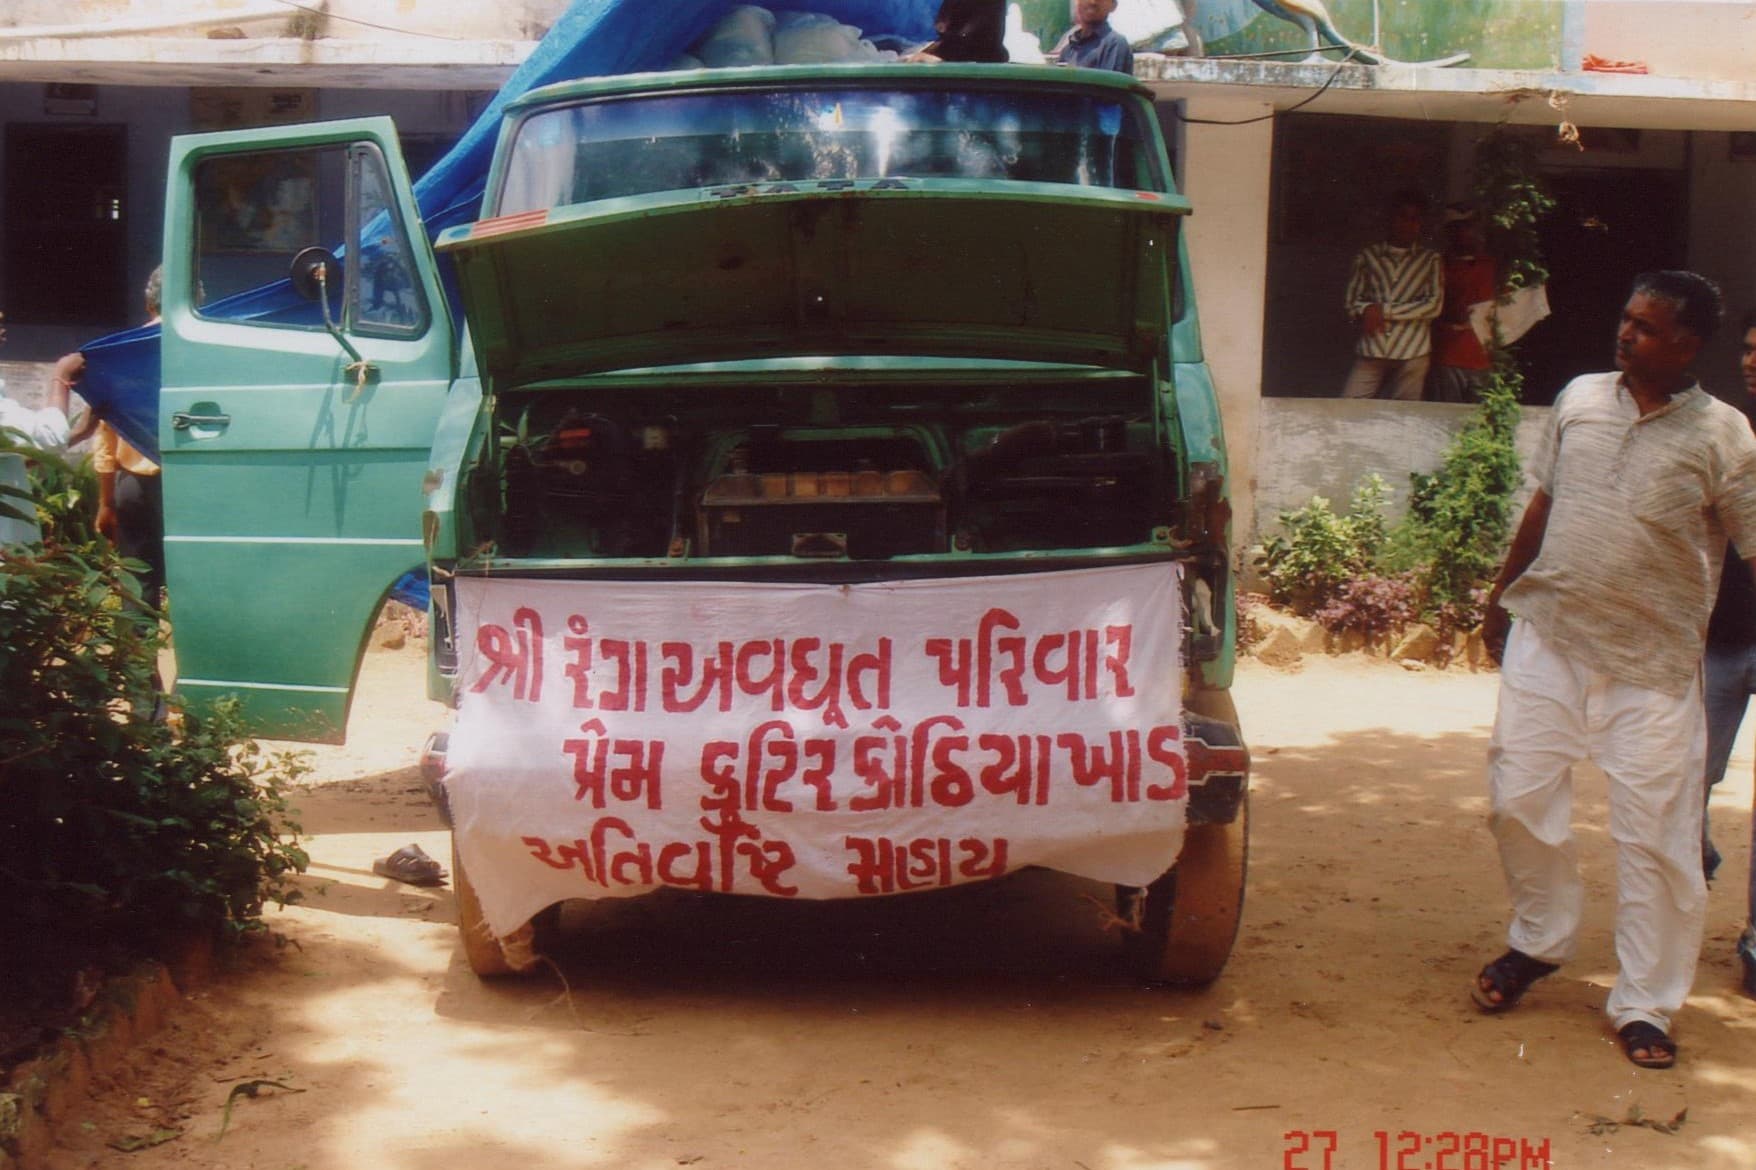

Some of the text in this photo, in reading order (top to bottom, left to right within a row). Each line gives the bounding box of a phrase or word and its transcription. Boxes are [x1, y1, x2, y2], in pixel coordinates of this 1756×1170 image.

[470, 607, 543, 702] શ્રી
[925, 607, 1135, 708] પરિવાર
[563, 718, 665, 812] પ્રેમ
[844, 835, 1008, 894] સહાય
